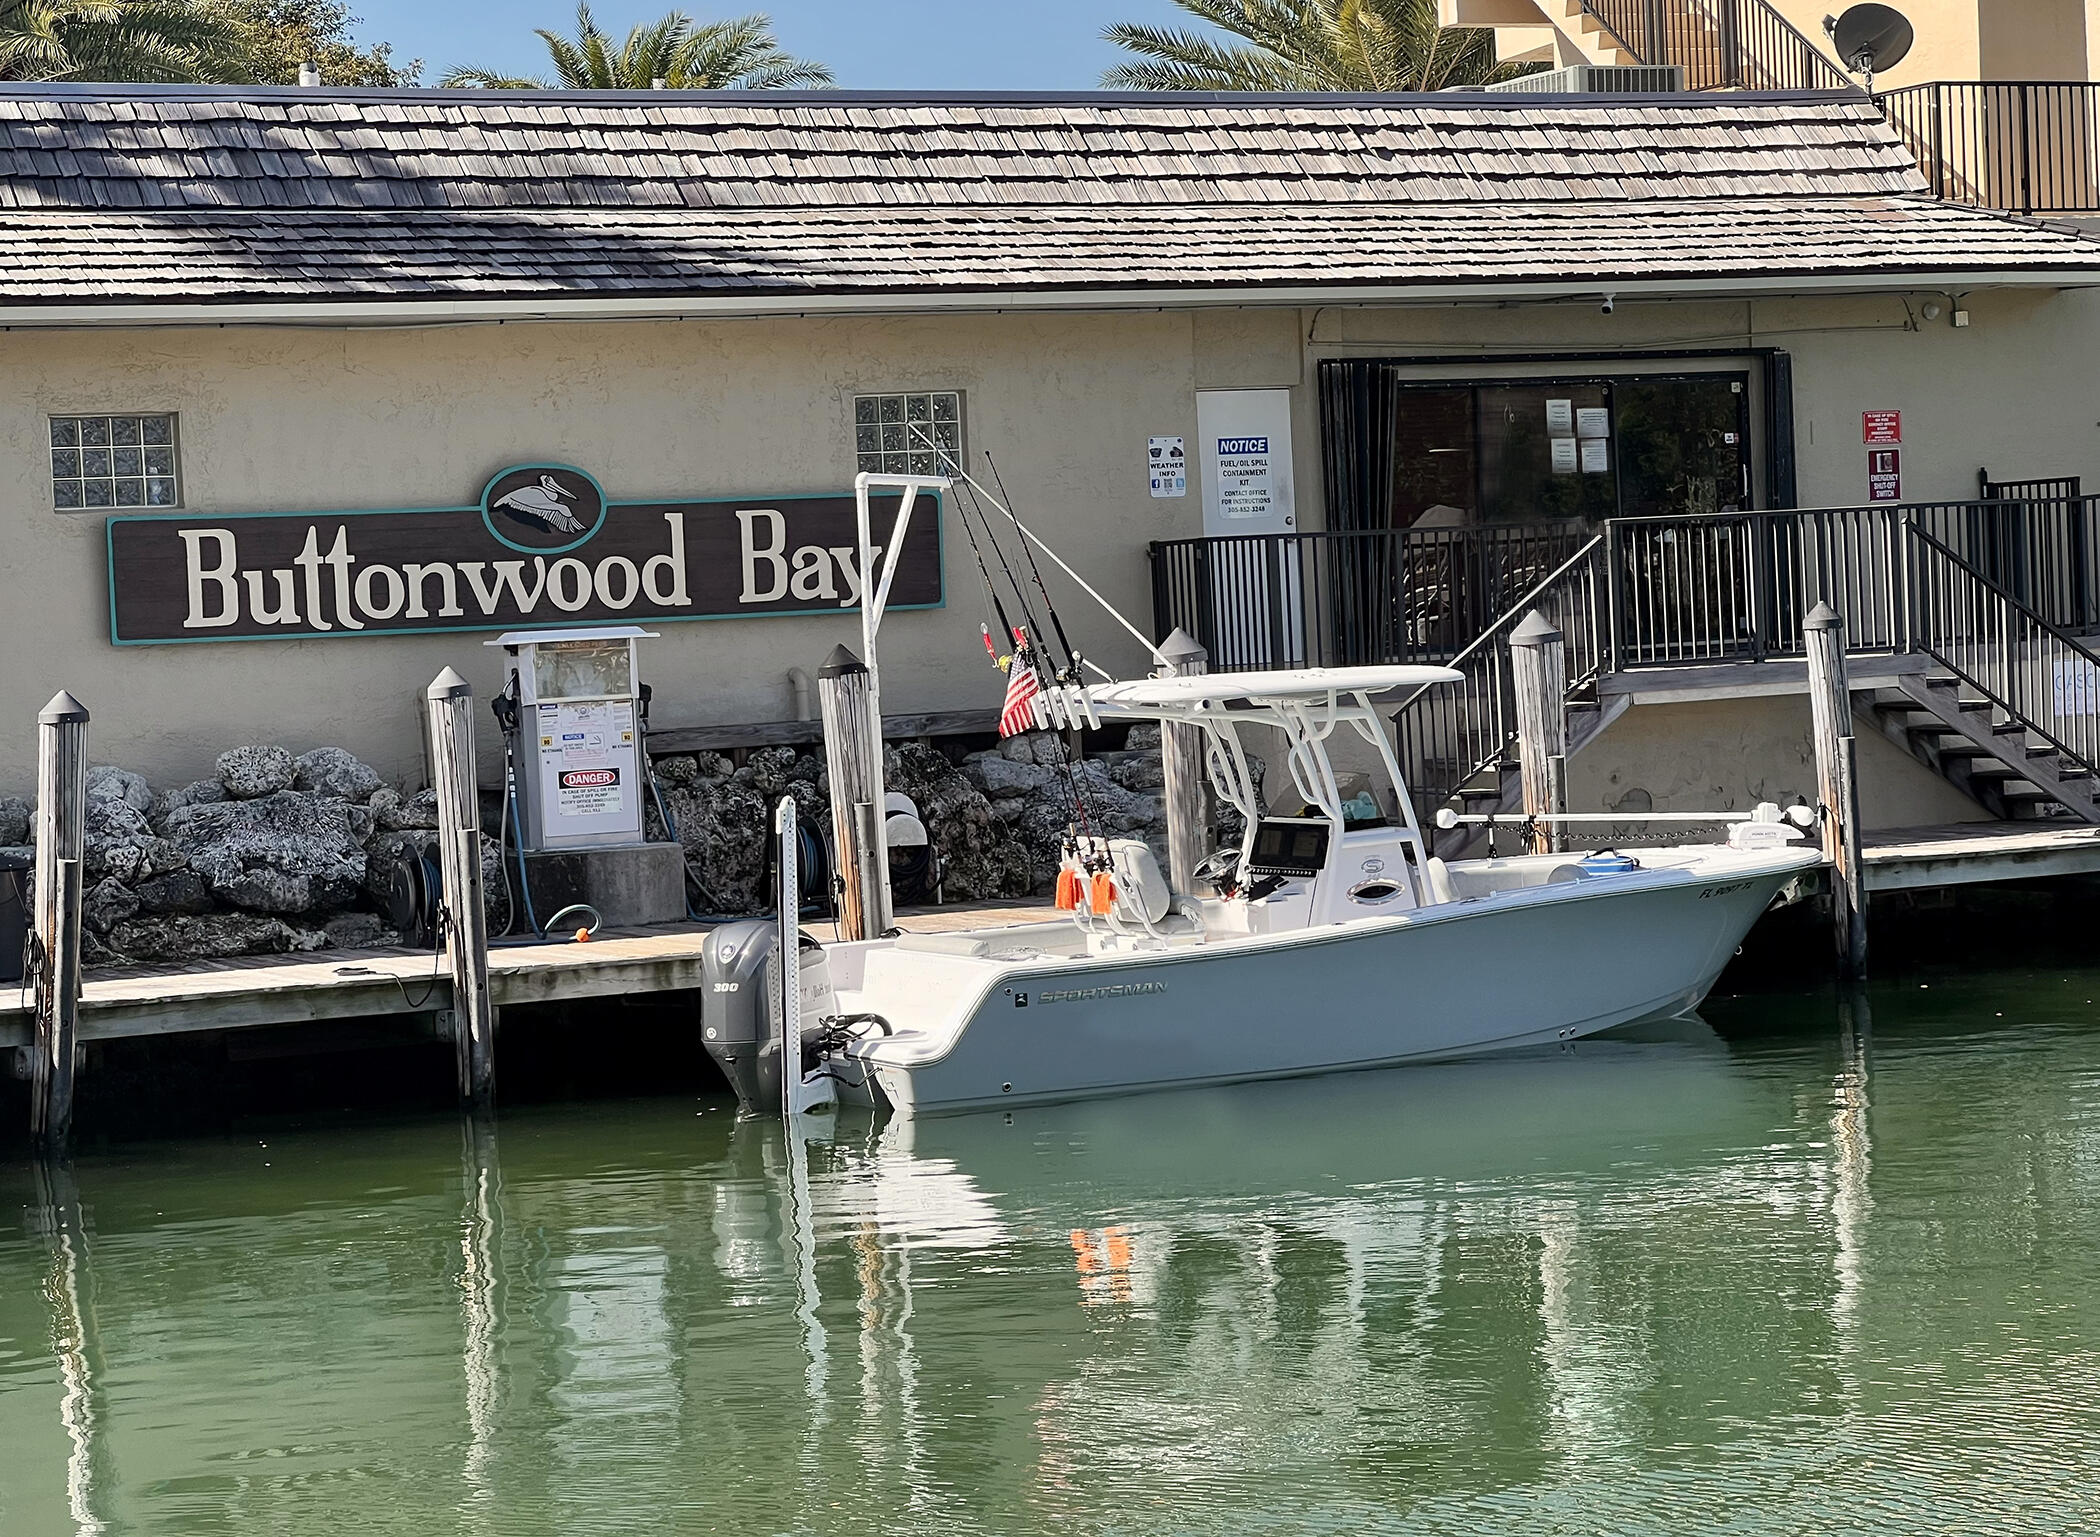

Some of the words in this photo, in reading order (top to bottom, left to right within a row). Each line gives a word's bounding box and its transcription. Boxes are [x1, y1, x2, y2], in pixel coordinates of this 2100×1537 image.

[1220, 439, 1266, 453] NOTICE
[1220, 460, 1250, 468] FUEL/OIL
[1222, 469, 1267, 477] CONTAINMENT
[178, 512, 692, 631] Buttonwood
[735, 509, 882, 607] Bay
[568, 772, 610, 785] DANGER
[713, 982, 740, 993] 300
[1037, 981, 1168, 1004] SPORTSMAN
